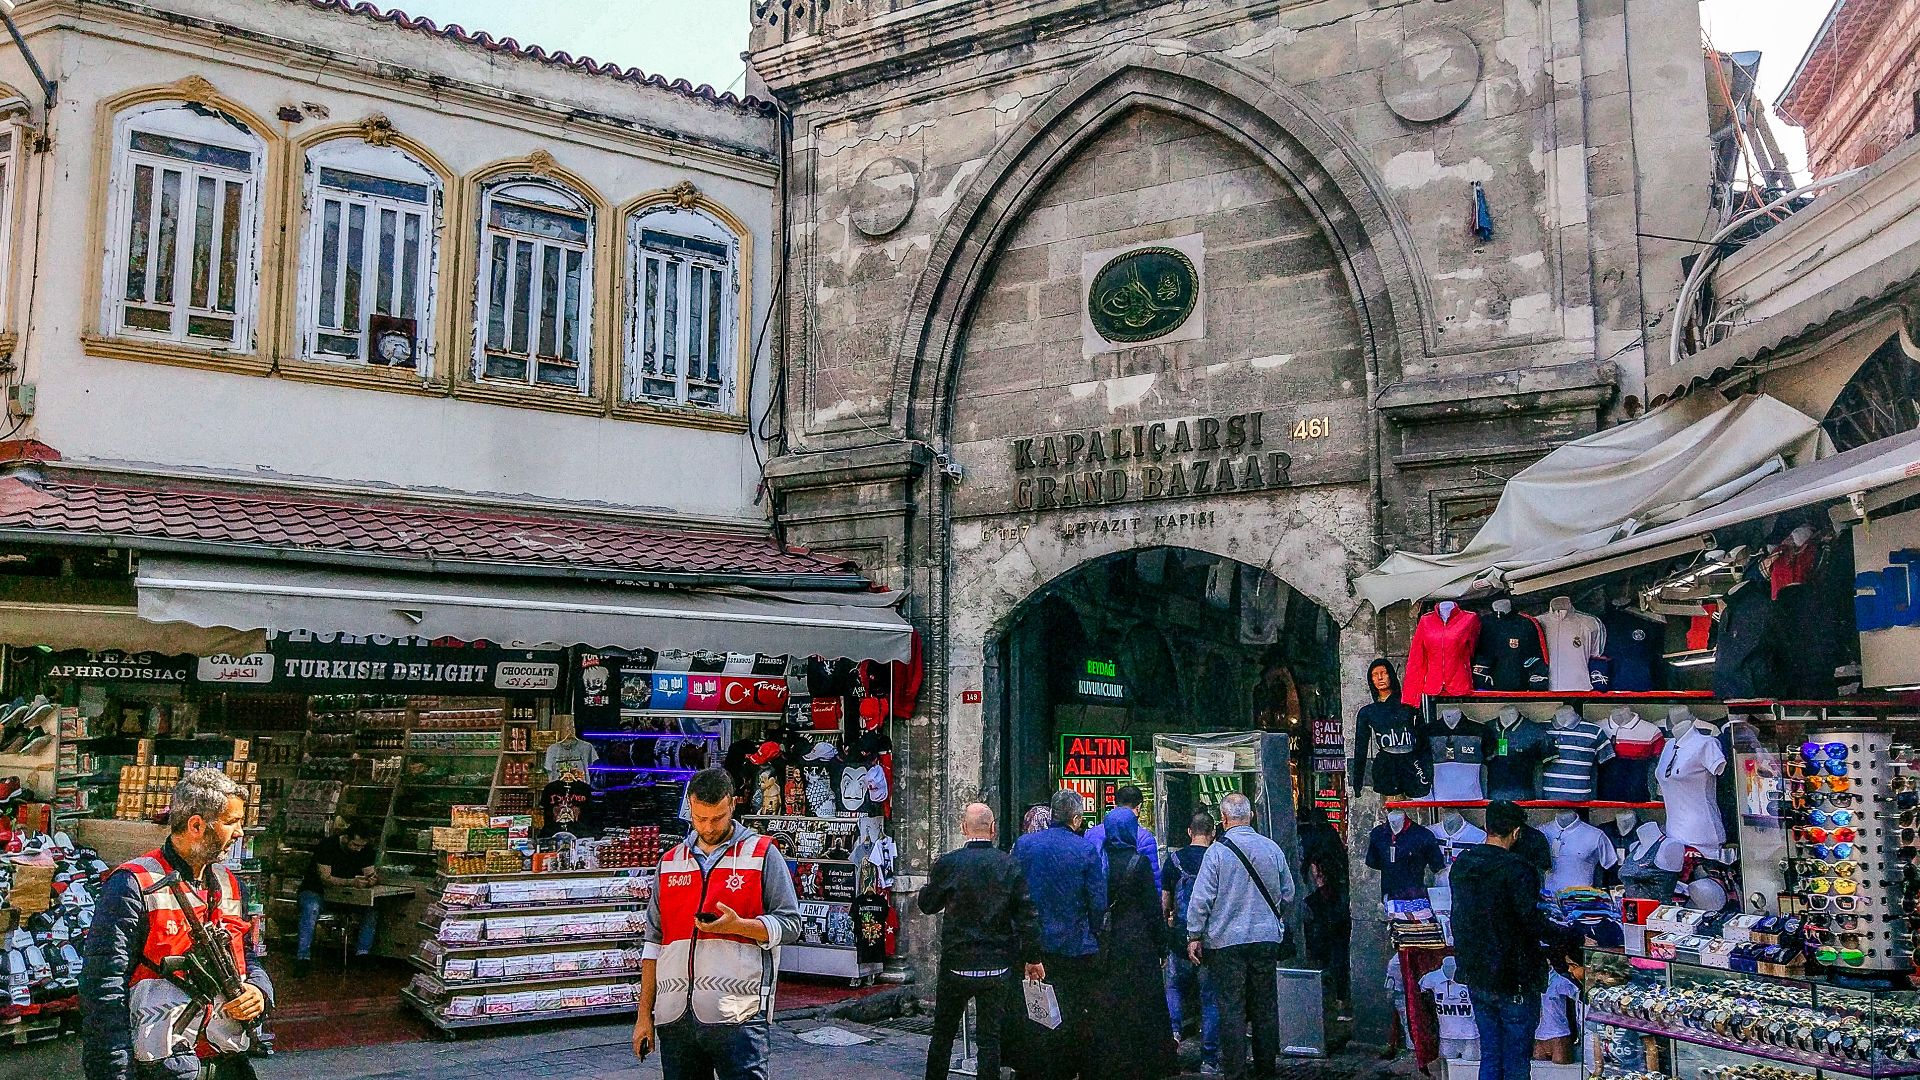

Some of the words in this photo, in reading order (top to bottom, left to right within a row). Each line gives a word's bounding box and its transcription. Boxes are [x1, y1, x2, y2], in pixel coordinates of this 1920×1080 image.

[1014, 411, 1264, 471] KAPALIÇARŞI
[1015, 469, 1129, 510] GRAND
[1141, 450, 1293, 500] BAZAAR
[981, 526, 1019, 541] GTE
[1019, 524, 1030, 539] 7
[1064, 517, 1140, 538] BEYAZIT
[1154, 510, 1215, 530] KAPISI
[87, 653, 152, 665] TEAS
[210, 655, 264, 666] CAVIAR
[49, 666, 187, 681] APHRODISIAC
[285, 658, 388, 680] TURKISH
[392, 663, 488, 682] DELIGHT
[501, 667, 554, 677] CHOCOLATE
[1078, 679, 1124, 698] KUYUMCULUK
[1070, 737, 1126, 756] ALTIN
[1461, 746, 1475, 754] EA7
[1064, 758, 1130, 775] ALINIR
[668, 874, 692, 888] 56-803
[803, 905, 824, 916] ARMY
